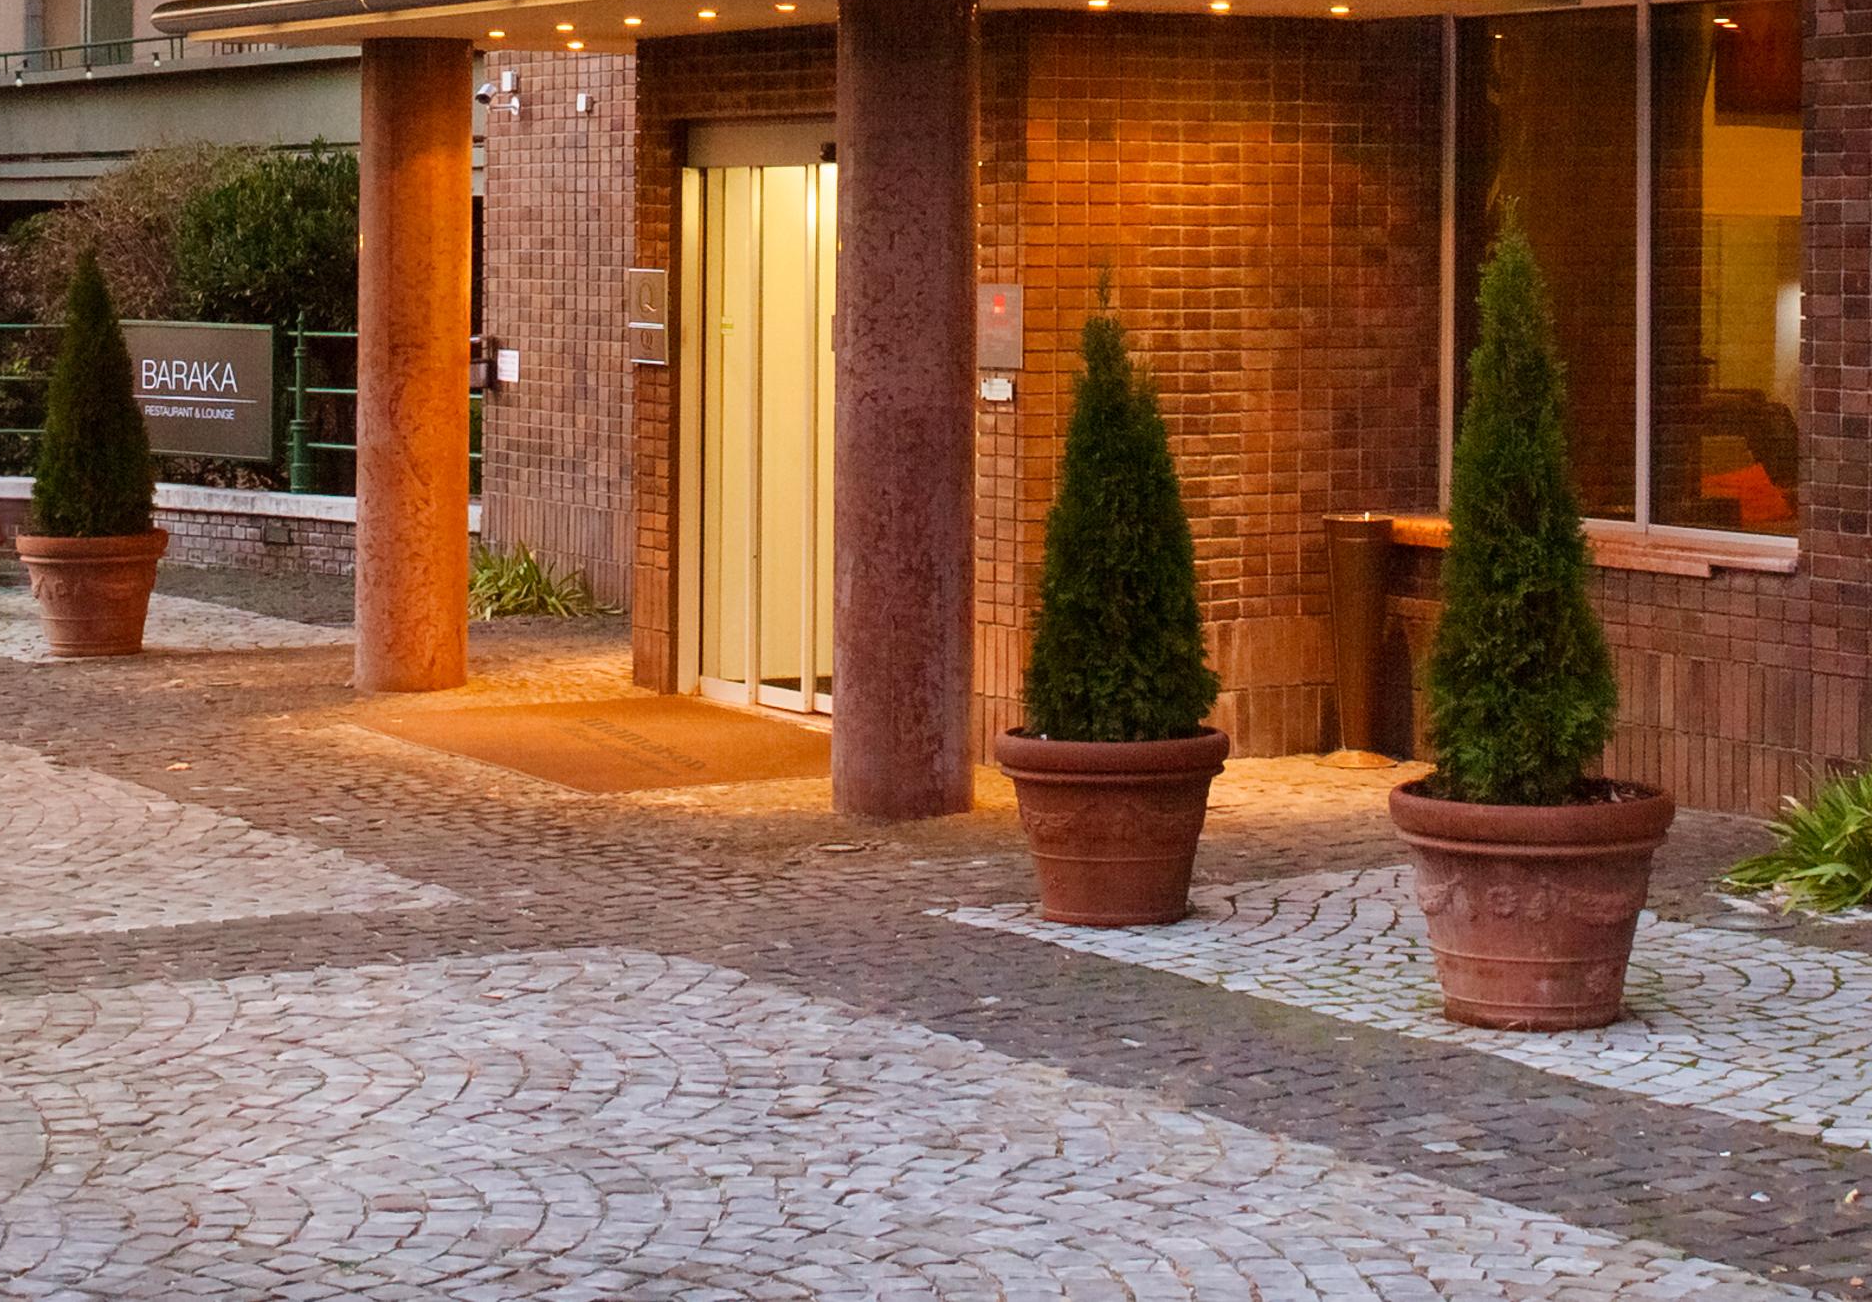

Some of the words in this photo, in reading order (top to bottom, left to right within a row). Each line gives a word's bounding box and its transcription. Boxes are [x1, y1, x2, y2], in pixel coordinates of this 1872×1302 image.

[141, 359, 238, 393] BARAKA
[144, 405, 193, 418] RESTAURANT
[195, 407, 201, 418] &
[202, 407, 235, 420] LOUNGE
